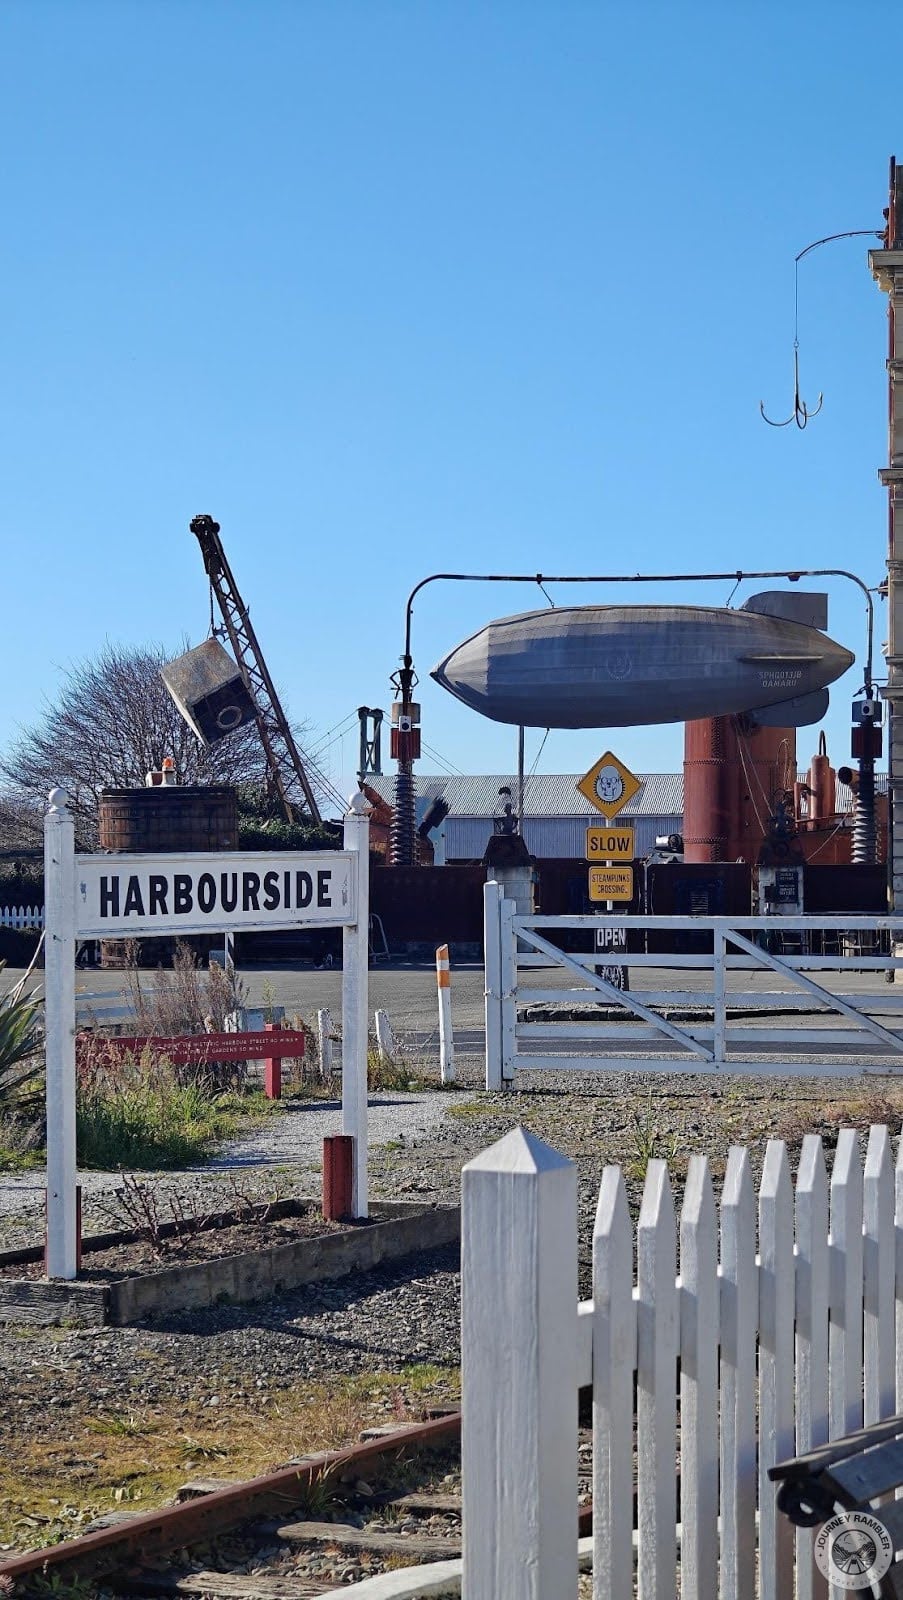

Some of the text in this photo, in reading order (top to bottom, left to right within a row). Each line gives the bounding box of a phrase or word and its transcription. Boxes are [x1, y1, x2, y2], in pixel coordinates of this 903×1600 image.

[762, 679, 797, 688] OAMARU
[590, 836, 630, 851] SLOW
[592, 874, 630, 883] STEAMPUNKS
[100, 870, 332, 917] HARBOURSIDE
[597, 928, 626, 947] OPEN
